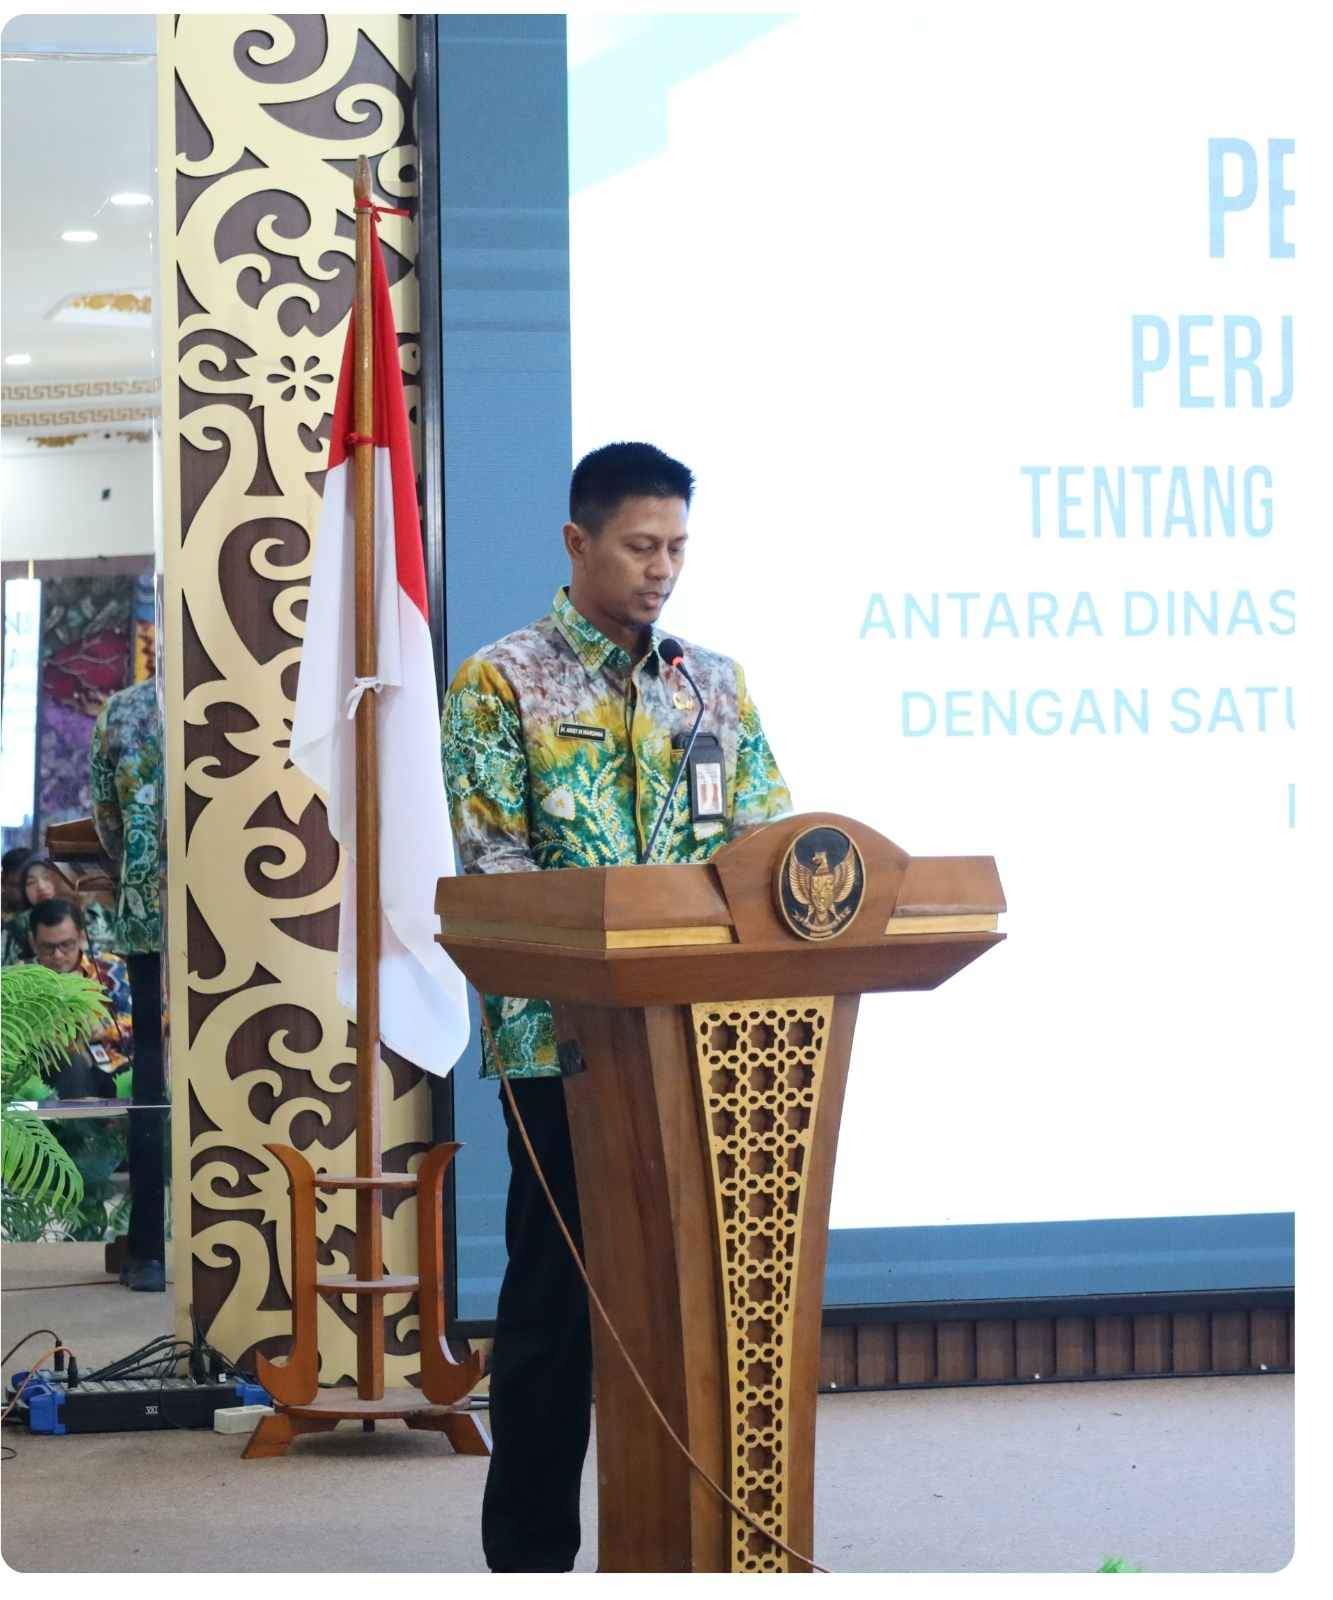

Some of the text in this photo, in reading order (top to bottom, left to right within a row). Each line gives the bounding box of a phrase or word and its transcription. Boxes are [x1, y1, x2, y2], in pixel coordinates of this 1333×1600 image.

[1020, 464, 1273, 539] TENTANG
[859, 589, 1295, 639] ANTARA DINAS
[902, 688, 1149, 737] DENGAN
